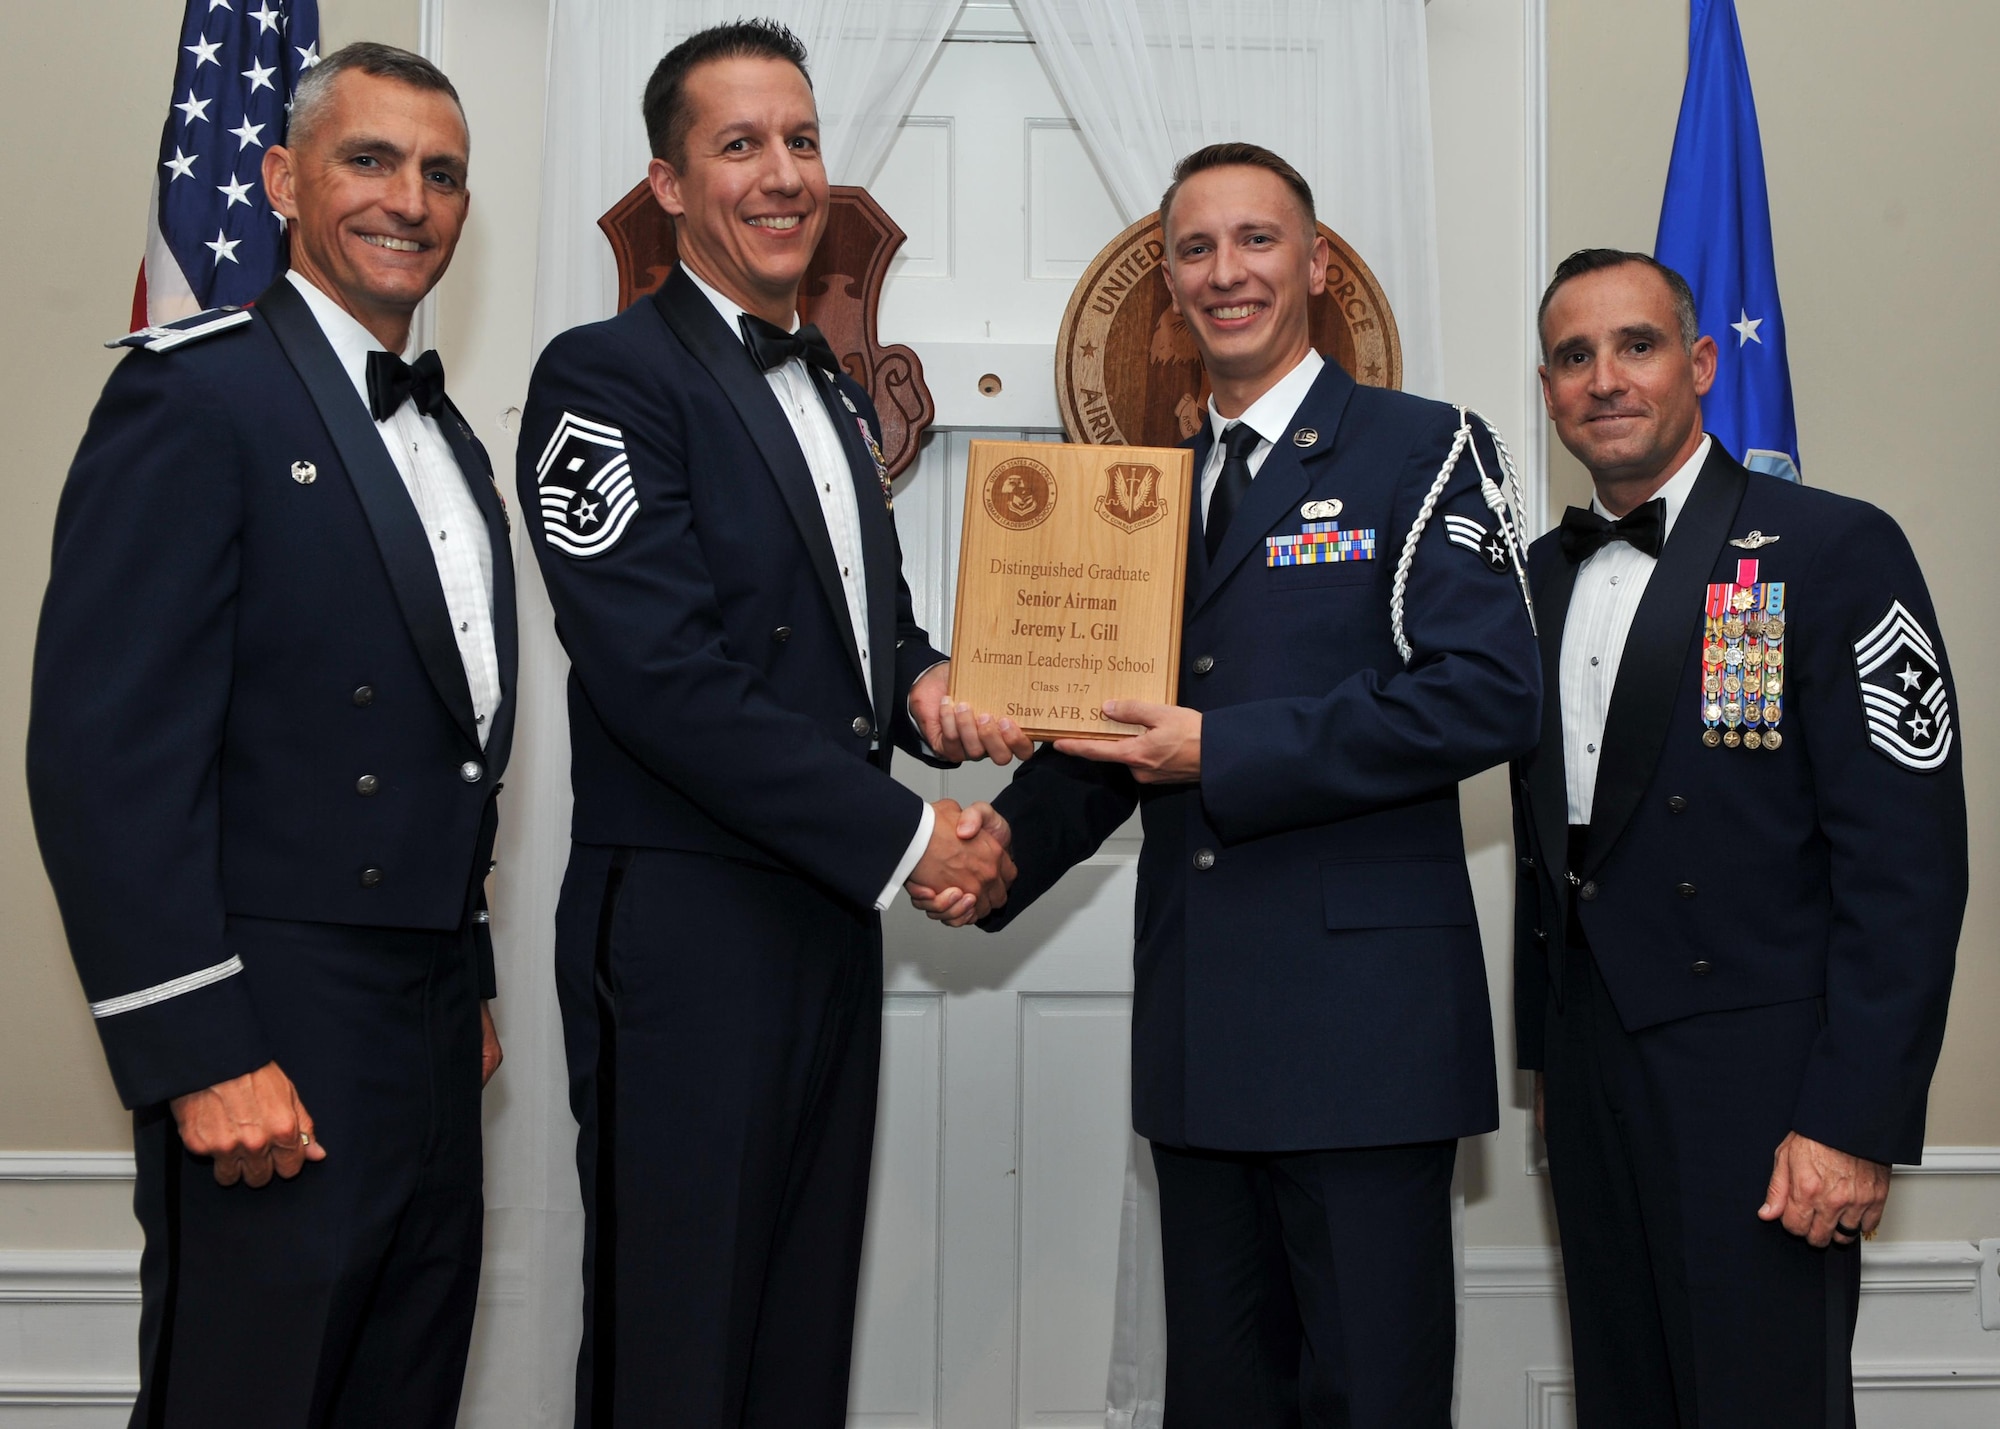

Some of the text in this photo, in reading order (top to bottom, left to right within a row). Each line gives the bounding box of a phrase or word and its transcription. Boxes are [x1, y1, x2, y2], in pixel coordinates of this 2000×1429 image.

[1092, 240, 1374, 334] UNITED ORCE
[989, 460, 1053, 486] UNITED STATES AIR FORCE
[986, 498, 1053, 528] AIRMAN LEADERSHIP SCHOOL
[990, 558, 1151, 582] Distinguished Graduate
[1016, 588, 1117, 611] Senior Airman
[1011, 618, 1119, 643] Jeremy L. Gill
[971, 647, 1156, 675] Airman Leadership School
[1030, 680, 1091, 695] Class 17-7
[1006, 702, 1045, 717] Shaw
[1047, 705, 1085, 722] AFB,
